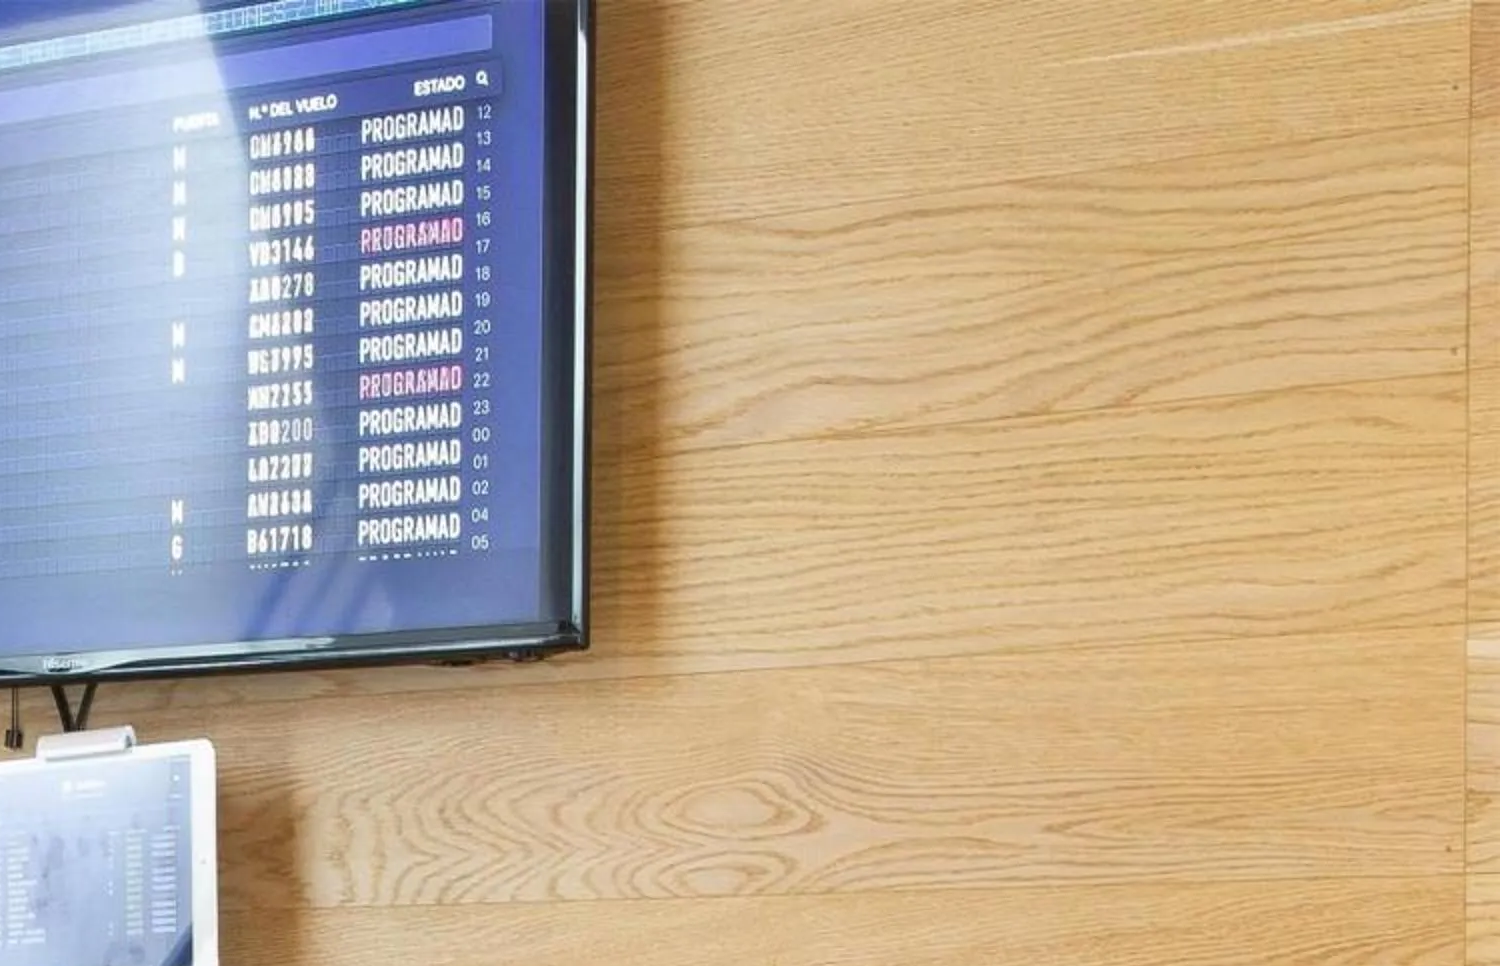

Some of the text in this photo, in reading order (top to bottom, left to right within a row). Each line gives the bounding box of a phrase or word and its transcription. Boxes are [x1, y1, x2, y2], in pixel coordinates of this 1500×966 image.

[413, 74, 466, 97] ESTADO
[270, 103, 293, 118] DEL
[295, 93, 338, 114] VUELO
[477, 104, 492, 120] 12
[361, 105, 465, 144] PROGRAMAD
[476, 130, 492, 146] 13
[361, 142, 464, 181] PROGRAMAD
[476, 158, 492, 173] 14
[361, 179, 464, 217] PROGRAMAD
[476, 185, 491, 201] 15
[476, 211, 492, 227] 16
[475, 239, 491, 254] 17
[360, 253, 463, 291] PROGRAMAD
[475, 265, 491, 281] 18
[475, 292, 491, 308] 19
[360, 290, 463, 327] PROGRAMAD
[473, 319, 491, 335] 20
[359, 327, 462, 364] PROGRAMAD
[475, 347, 490, 362] 21
[473, 373, 491, 389] 22
[472, 400, 491, 415] 23
[359, 401, 462, 437] PROGRAMAD
[472, 427, 491, 442] 00
[358, 439, 461, 473] PROGRAMAD
[472, 453, 489, 469] 01
[358, 475, 461, 509] PROGRAMAD
[472, 480, 489, 496] 02
[471, 508, 489, 523] 04
[358, 512, 461, 545] PROGRAMAD
[471, 535, 489, 550] 05
